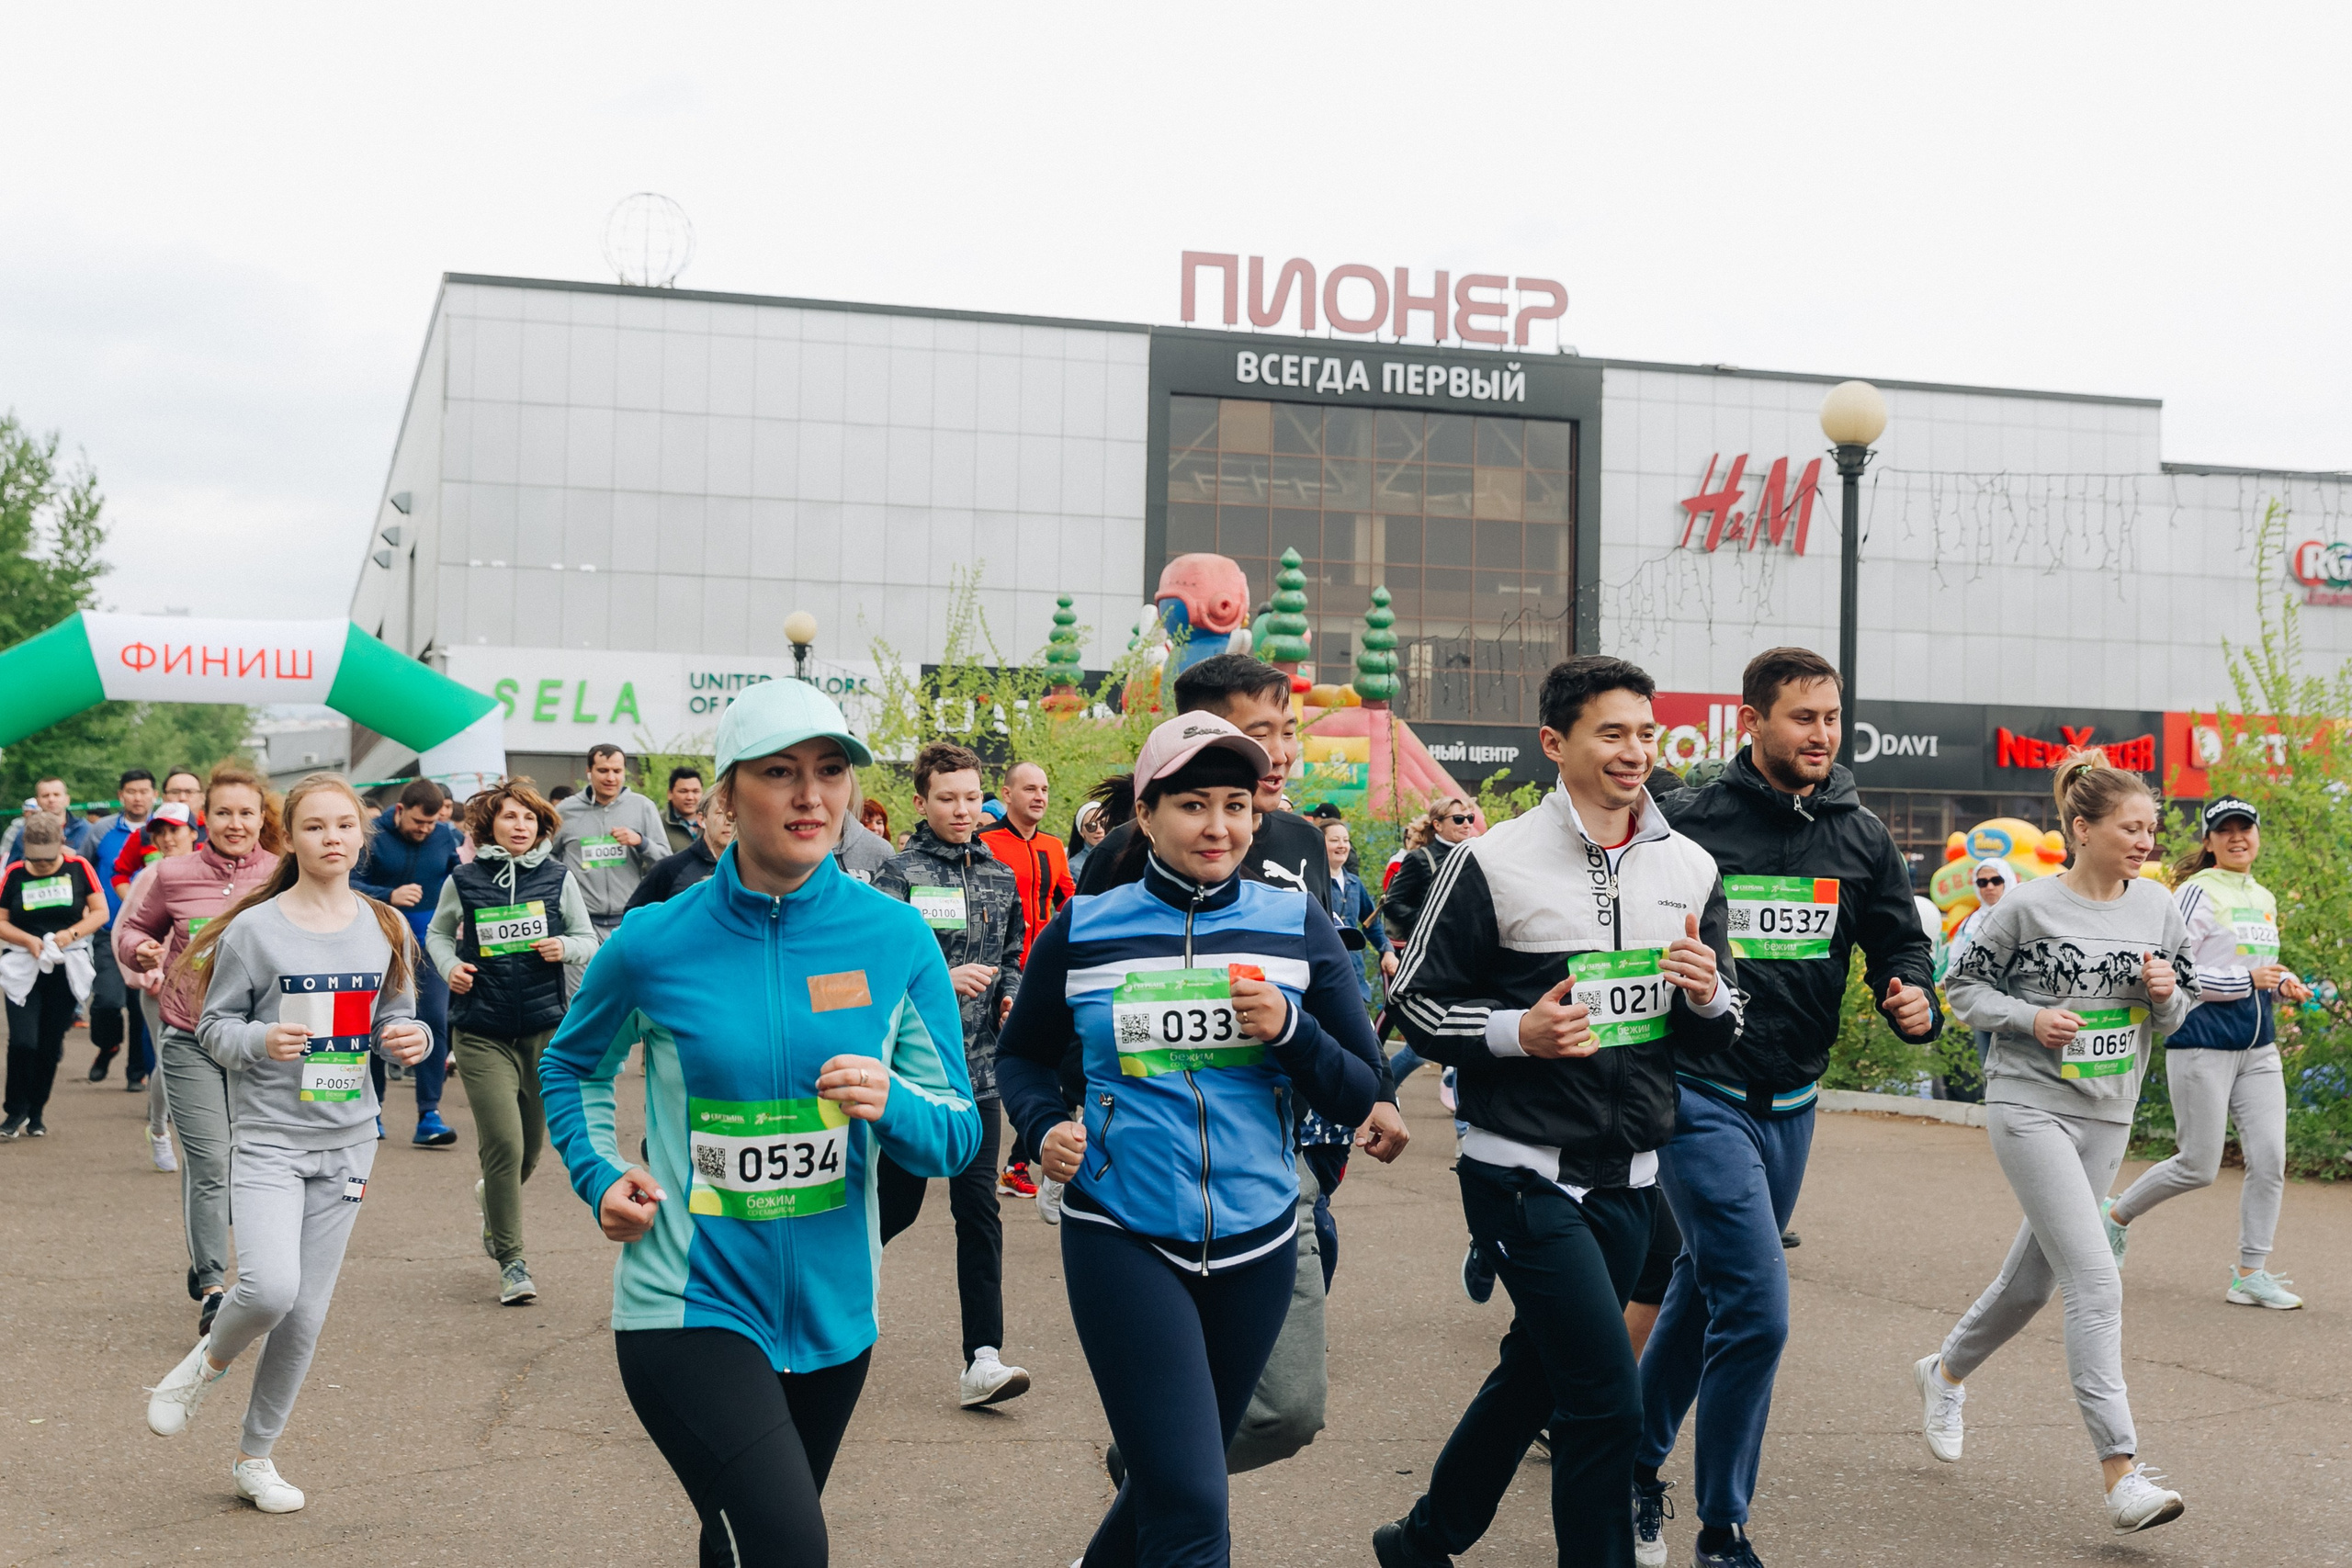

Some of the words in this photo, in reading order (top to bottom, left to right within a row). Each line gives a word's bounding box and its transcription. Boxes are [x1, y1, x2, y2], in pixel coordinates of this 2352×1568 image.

[1181, 251, 1568, 345] ПИОНЕР
[1237, 351, 1370, 395] ВСЕГДА
[1382, 361, 1525, 402] ПЕРВЫЙ
[1680, 453, 1822, 557] H&M
[121, 641, 312, 680] ФИНИШ
[494, 678, 640, 724] SELA
[690, 696, 718, 714] OF
[1468, 745, 1520, 764] ЦЕНТР
[595, 846, 624, 857] 0005
[1585, 843, 1612, 927] adidas
[922, 908, 956, 918] P-0100
[1657, 900, 1682, 909] adidas
[499, 919, 542, 939] 0269
[1759, 907, 1830, 934] 0537
[1764, 941, 1797, 952] бежим
[283, 975, 381, 991] TOMMY
[1162, 1008, 1253, 1043] 033
[1617, 1022, 1651, 1036] бежим
[305, 1038, 372, 1054] EAN
[2093, 1029, 2136, 1056] 0697
[1170, 1051, 1214, 1061] бежим
[316, 1077, 356, 1089] P-0057
[739, 1138, 839, 1183] 0534
[746, 1194, 797, 1210] бежим
